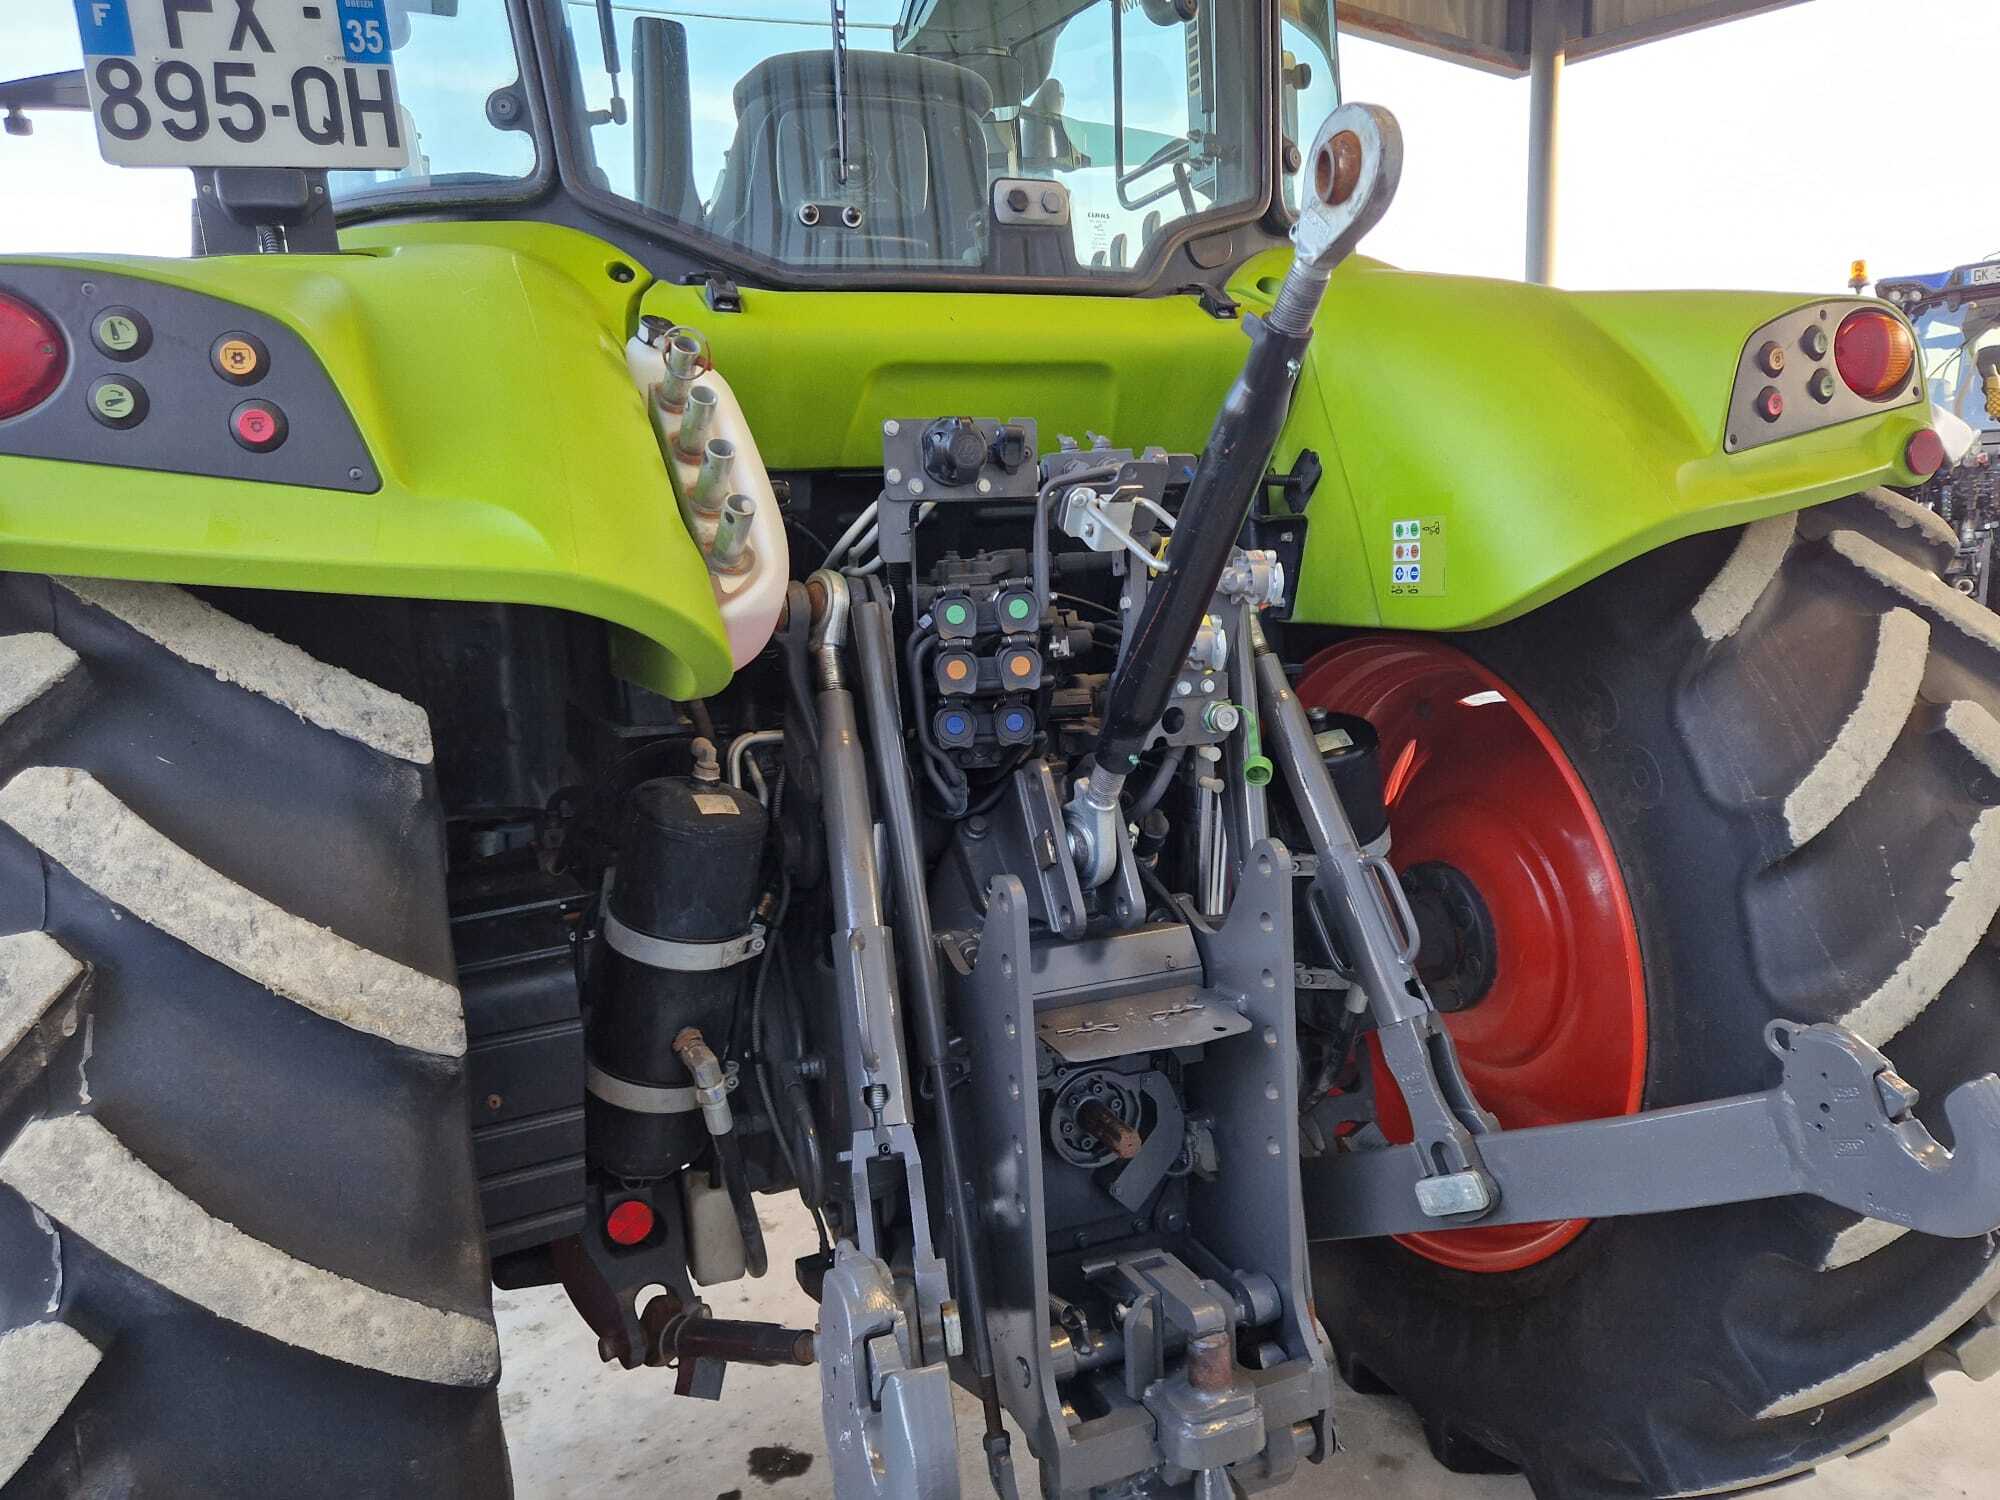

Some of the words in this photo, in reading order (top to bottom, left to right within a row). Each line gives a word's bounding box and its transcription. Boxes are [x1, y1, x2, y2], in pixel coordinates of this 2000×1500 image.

[92, 3, 112, 27] F
[346, 19, 384, 54] 35
[95, 58, 400, 147] 895-QH
